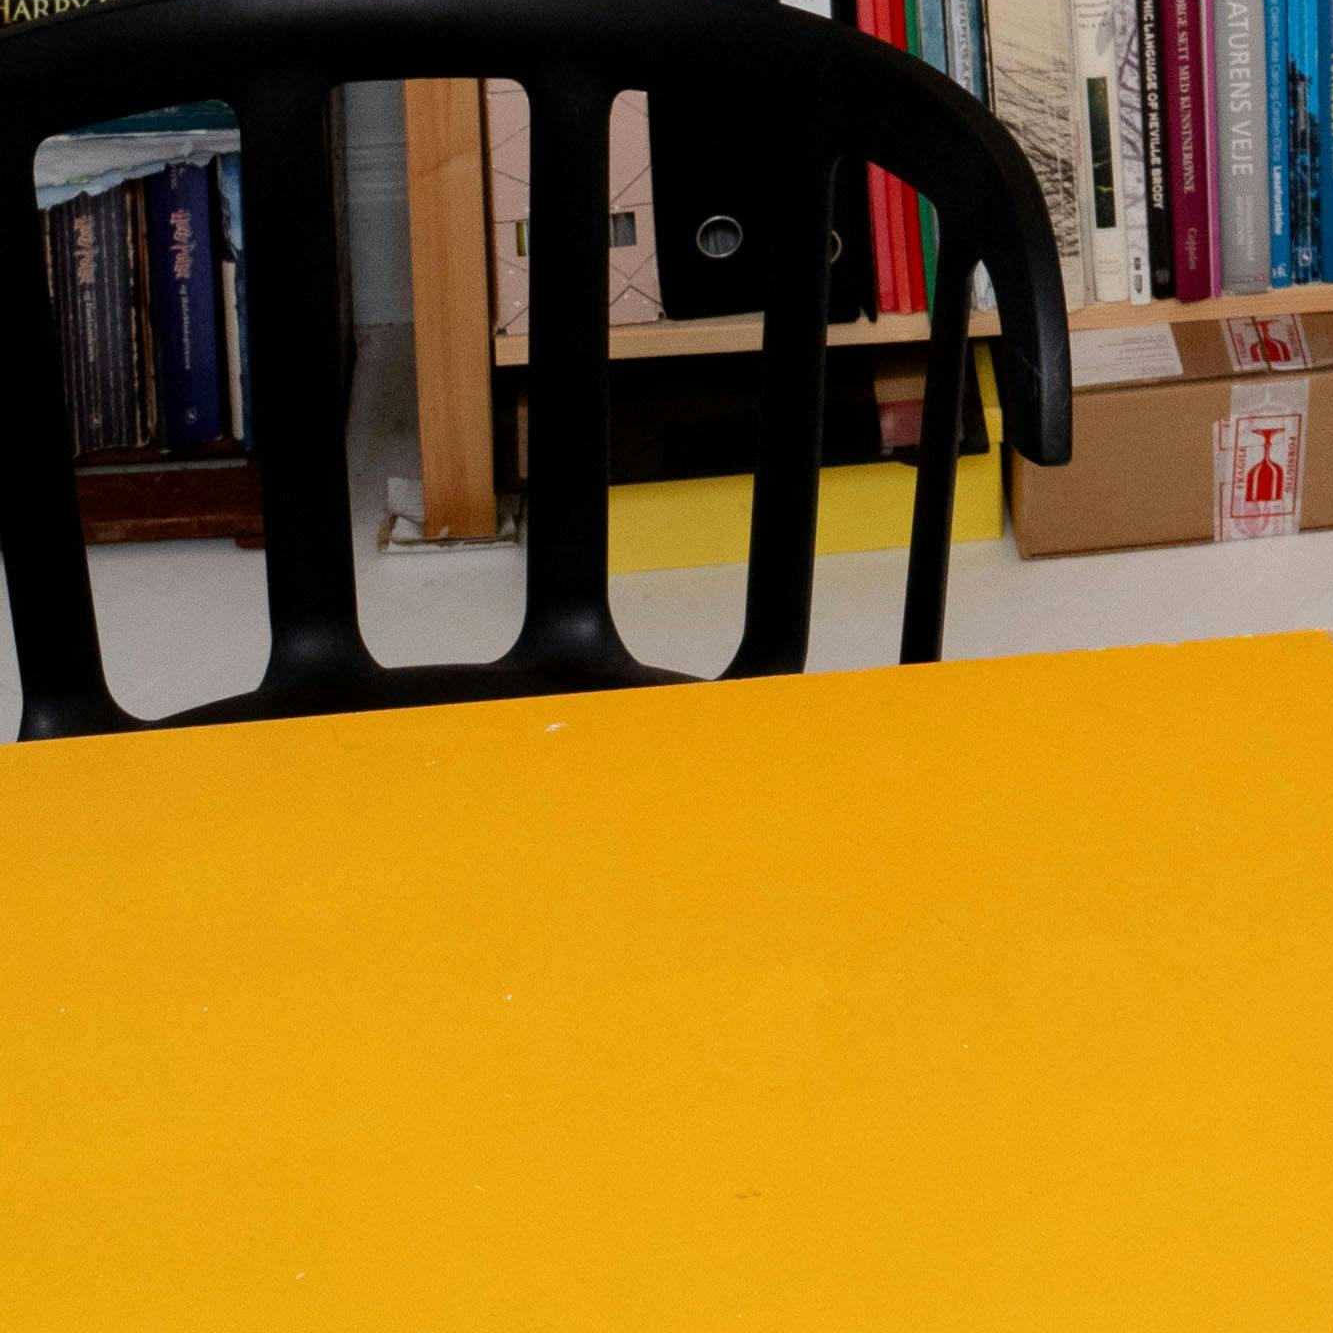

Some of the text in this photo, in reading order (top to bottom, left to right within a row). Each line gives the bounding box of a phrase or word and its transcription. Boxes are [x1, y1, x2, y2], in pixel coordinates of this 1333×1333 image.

[1147, 92, 1159, 109] OF
[1230, 121, 1253, 176] VEJE
[1236, 446, 1247, 490] FRAGILE
